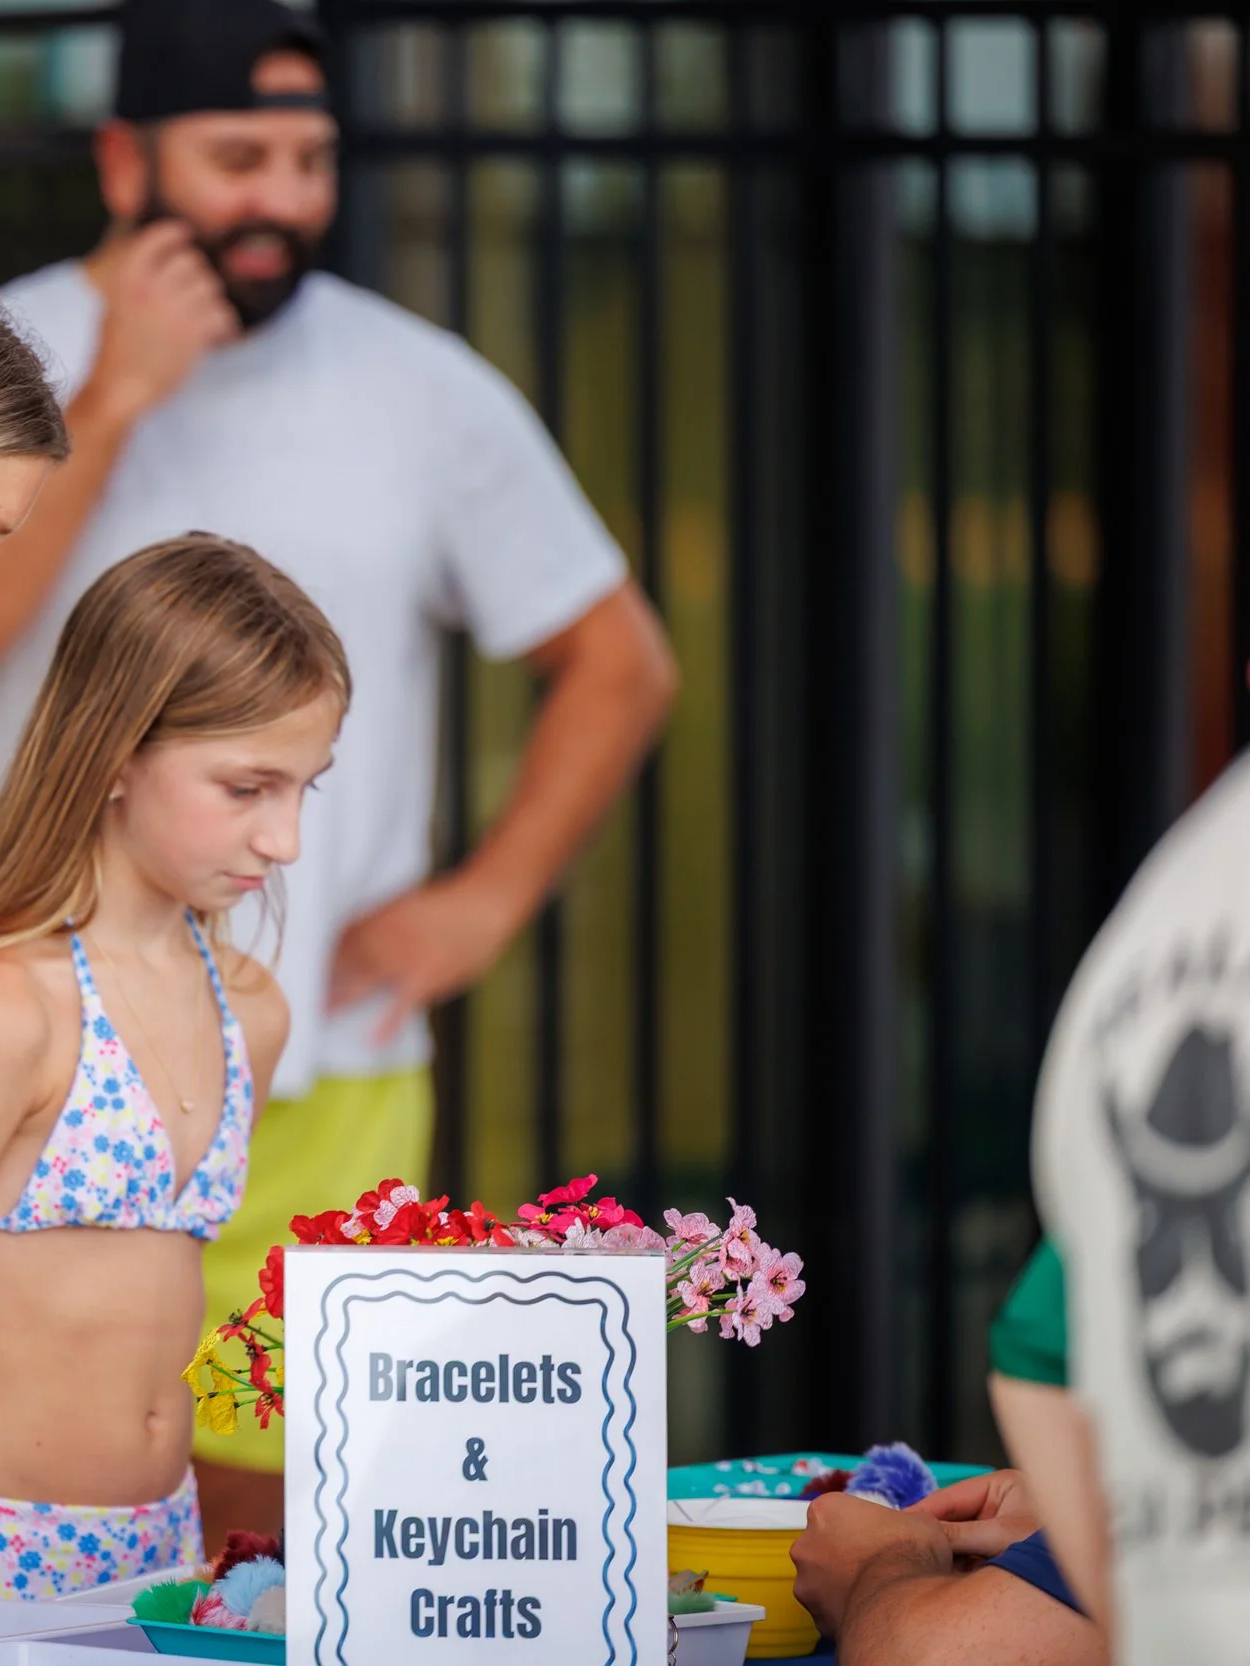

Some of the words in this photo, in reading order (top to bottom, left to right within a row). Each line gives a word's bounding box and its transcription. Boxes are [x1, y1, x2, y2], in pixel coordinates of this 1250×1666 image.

[369, 1353, 582, 1403] Bracelets
[462, 1437, 488, 1482] &
[373, 1509, 577, 1566] Keychain
[410, 1588, 542, 1638] Crafts
